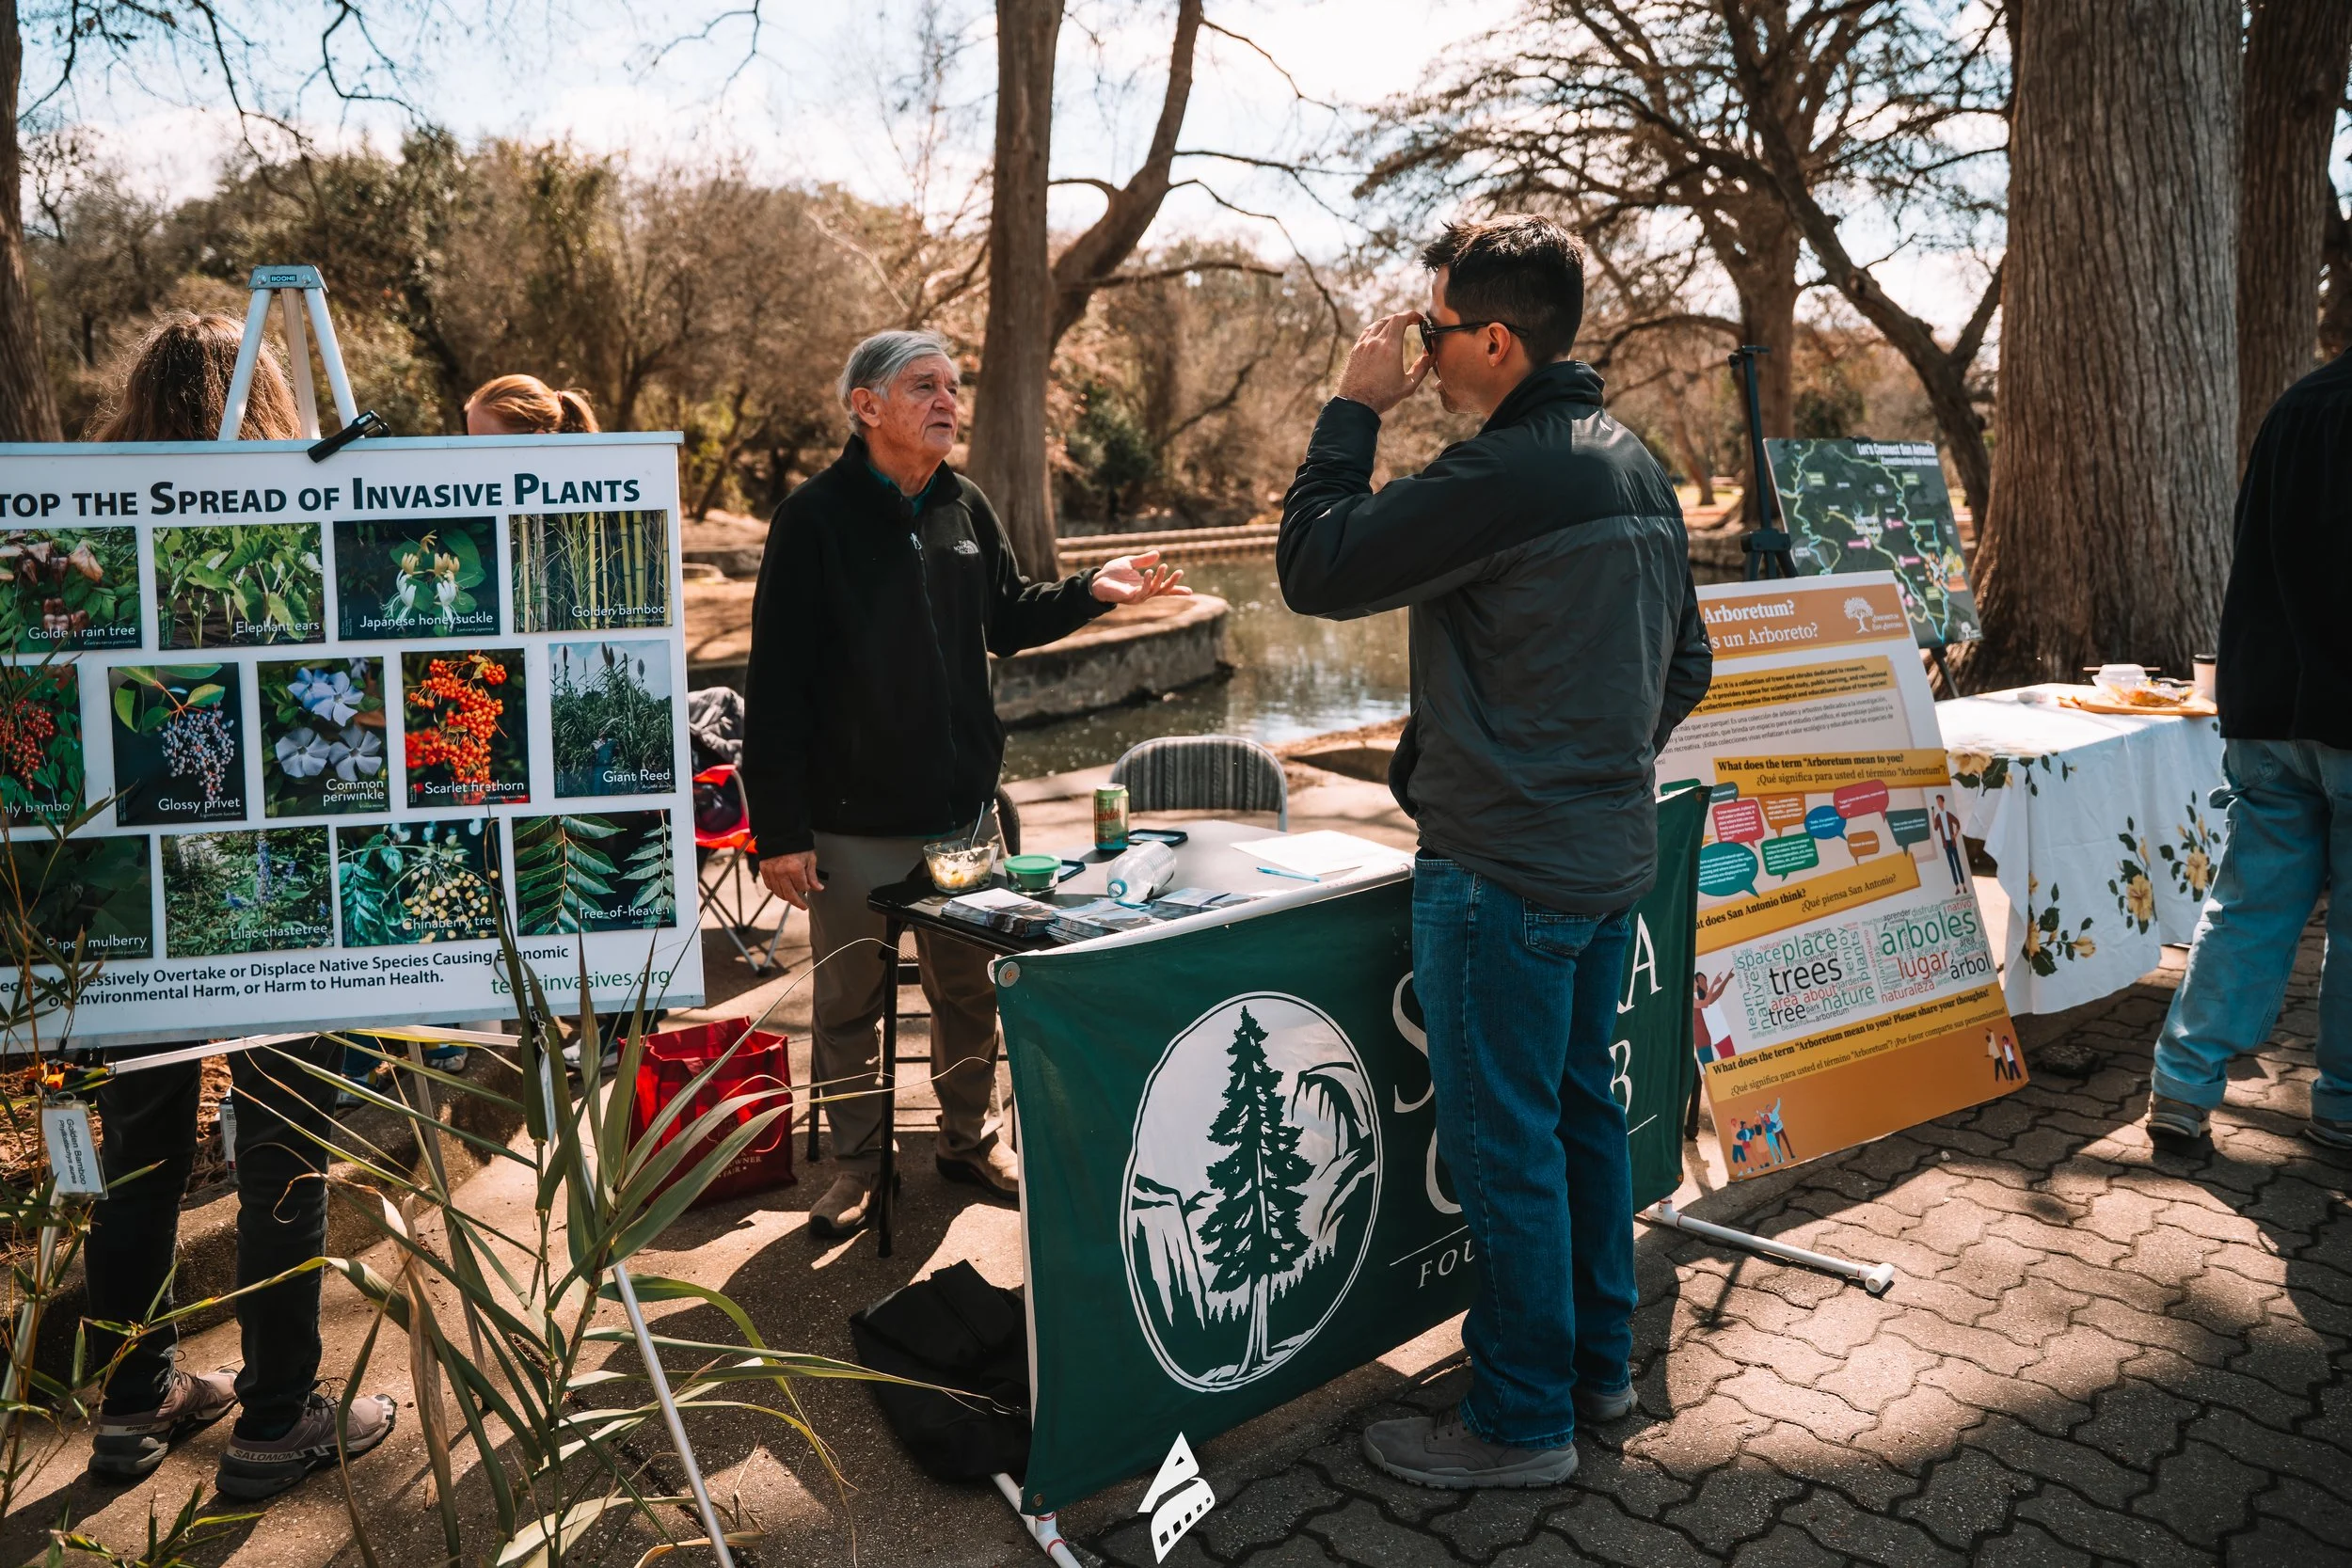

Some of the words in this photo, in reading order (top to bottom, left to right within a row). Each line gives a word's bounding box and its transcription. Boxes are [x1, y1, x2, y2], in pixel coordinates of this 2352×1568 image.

[72, 491, 139, 516] THE
[297, 487, 340, 512] OF
[571, 605, 615, 618] Golden
[618, 602, 666, 615] bamboo
[1704, 599, 1795, 624] Arboretum?
[235, 620, 291, 637] Elephant
[295, 621, 320, 631] ears
[359, 615, 416, 631] Japanese
[419, 610, 494, 626] honeysuckle
[81, 626, 105, 638] rain
[109, 625, 135, 636] tree
[1723, 631, 1745, 648] un
[1748, 622, 1820, 645] Arboreto?
[1718, 760, 1741, 771] What
[1744, 759, 1764, 770] does
[1766, 758, 1780, 768] the
[1782, 758, 1803, 768] term
[1854, 755, 1875, 765] mean
[1877, 753, 1885, 764] to
[1887, 752, 1904, 766] you?
[326, 779, 384, 791] Common
[603, 770, 637, 783] Giant
[640, 768, 670, 781] Reed
[1756, 772, 1776, 786] ¿Qué
[1778, 771, 1813, 785] significa
[1815, 773, 1833, 784] para
[1835, 769, 1855, 780] usted
[1857, 769, 1865, 779] el
[1867, 768, 1897, 779] término
[424, 781, 467, 794] Scarlet
[470, 779, 524, 792] firethorn
[25, 800, 72, 813] bambo
[158, 798, 200, 814] Glossy
[204, 798, 241, 813] privet
[323, 788, 385, 807] periwinkle
[1801, 899, 1821, 912] ¿Qué
[1822, 890, 1848, 907] piensa
[1849, 885, 1863, 896] San
[1864, 873, 1897, 892] Antonio?
[579, 905, 670, 919] Tree-of-heaven
[1706, 913, 1725, 928] does
[1726, 908, 1743, 922] San
[1745, 898, 1779, 915] Antonio
[1780, 888, 1806, 905] think?
[1883, 909, 1911, 922] aprender
[1912, 903, 1943, 917] disfrutar
[1947, 900, 1972, 912] nativo
[230, 927, 259, 940] Lilac
[262, 925, 327, 938] chastetree
[403, 917, 471, 935] Chinaberry
[474, 915, 498, 927] tree
[1804, 927, 1831, 939] museum
[1881, 910, 1978, 957] árboles
[47, 937, 77, 954] Ppe
[87, 934, 148, 949] mulberry
[1782, 932, 1838, 967] place
[1837, 927, 1854, 973] enjoy
[153, 966, 226, 982] Overtake
[230, 967, 246, 978] or
[251, 960, 315, 978] Displace
[320, 957, 369, 973] Native
[373, 953, 429, 972] Species
[433, 950, 492, 966] Causing
[497, 945, 569, 962] Enomic
[1737, 947, 1782, 971] space
[1805, 950, 1837, 963] sanctuary
[1850, 930, 1871, 981] plants
[1897, 950, 1948, 980] lugar
[1949, 951, 1991, 980] árbol
[194, 984, 240, 998] Harm,
[245, 983, 261, 994] or
[264, 979, 307, 993] Harm
[311, 977, 326, 990] to
[331, 975, 386, 989] Human
[390, 970, 444, 986] Health.
[491, 969, 671, 994] teainvasives.org
[1769, 958, 1842, 995] trees
[1836, 975, 1863, 990] garden
[1749, 967, 1772, 1030] native
[1803, 984, 1837, 1004] about
[1822, 985, 1875, 1012] nature
[1881, 979, 1935, 1004] naturaleza
[1742, 992, 1758, 1031] learn
[1771, 993, 1799, 1011] area
[1806, 1003, 1820, 1014] park
[1769, 1004, 1806, 1026] tree
[1815, 1006, 1851, 1022] arboretum
[1711, 1060, 1737, 1075] What
[1738, 1054, 1758, 1069] does
[1758, 1051, 1773, 1062] the
[1774, 1045, 1795, 1058] term
[1844, 1025, 1866, 1039] mean
[1866, 1021, 1875, 1032] to
[1875, 1016, 1892, 1032] you?
[1894, 1010, 1917, 1024] Please
[1917, 1004, 1938, 1018] share
[1938, 999, 1956, 1014] your
[1956, 989, 1990, 1006] thoughts!
[1730, 1082, 1748, 1097] ¿Qué
[1749, 1073, 1779, 1090] significa
[1780, 1069, 1796, 1083] para
[1797, 1062, 1816, 1076] usted
[1816, 1060, 1823, 1070] el
[1823, 1053, 1851, 1068] término
[1894, 1036, 1907, 1048] ¡Por
[1908, 1031, 1924, 1042] favor
[1925, 1023, 1954, 1037] comparte
[1954, 1019, 1964, 1028] sus
[1964, 1006, 2006, 1028] pensamientos!
[67, 1118, 78, 1148] Golden
[74, 1149, 87, 1185] Bamboo
[233, 1449, 294, 1462] SALOMON
